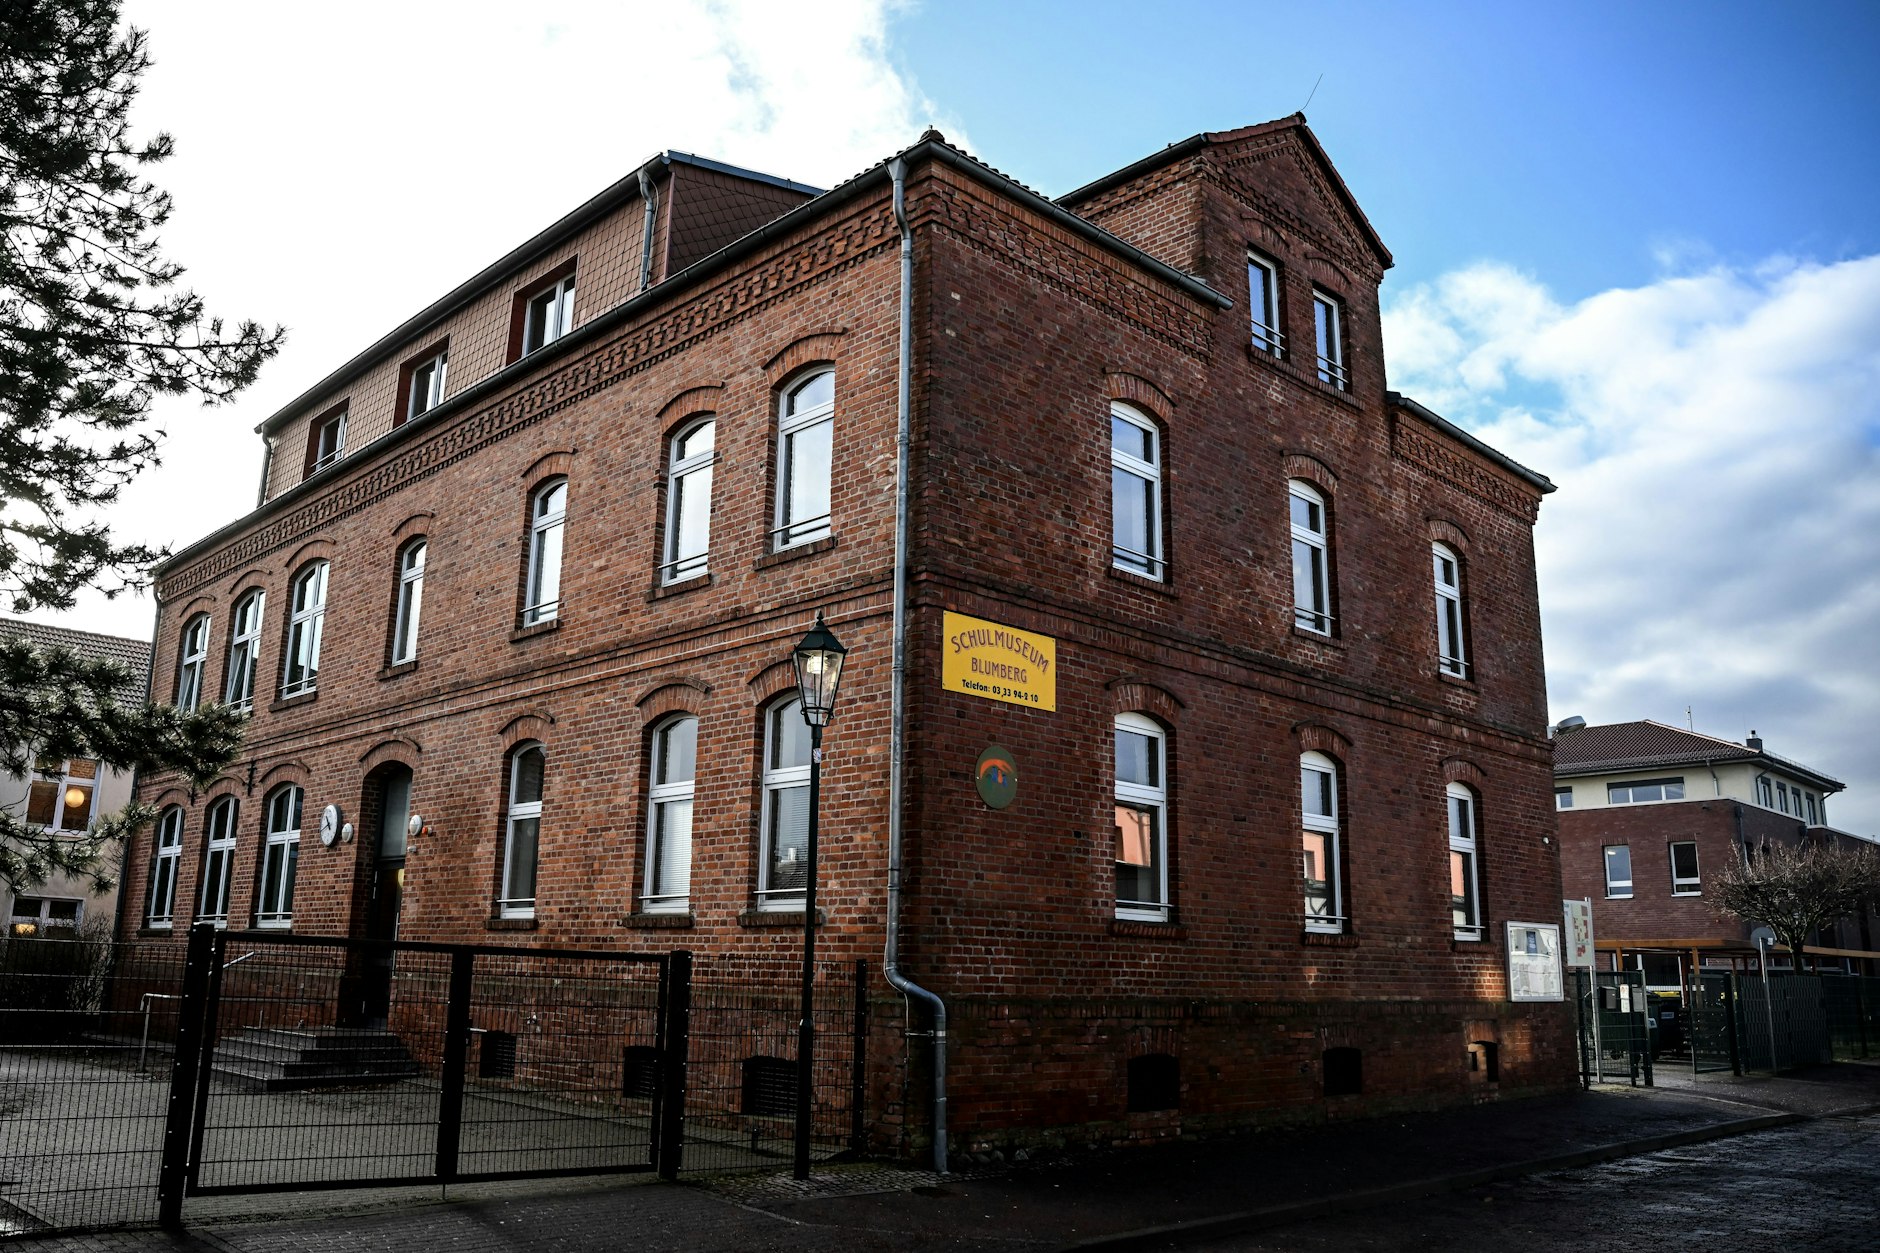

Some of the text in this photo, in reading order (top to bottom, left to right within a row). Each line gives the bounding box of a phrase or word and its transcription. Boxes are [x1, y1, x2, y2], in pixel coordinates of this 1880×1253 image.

[951, 629, 1049, 673] SCHULMUSEUM
[971, 657, 1028, 683] BLUMBERG
[962, 679, 991, 692] Telefon:
[992, 684, 1001, 695] 03
